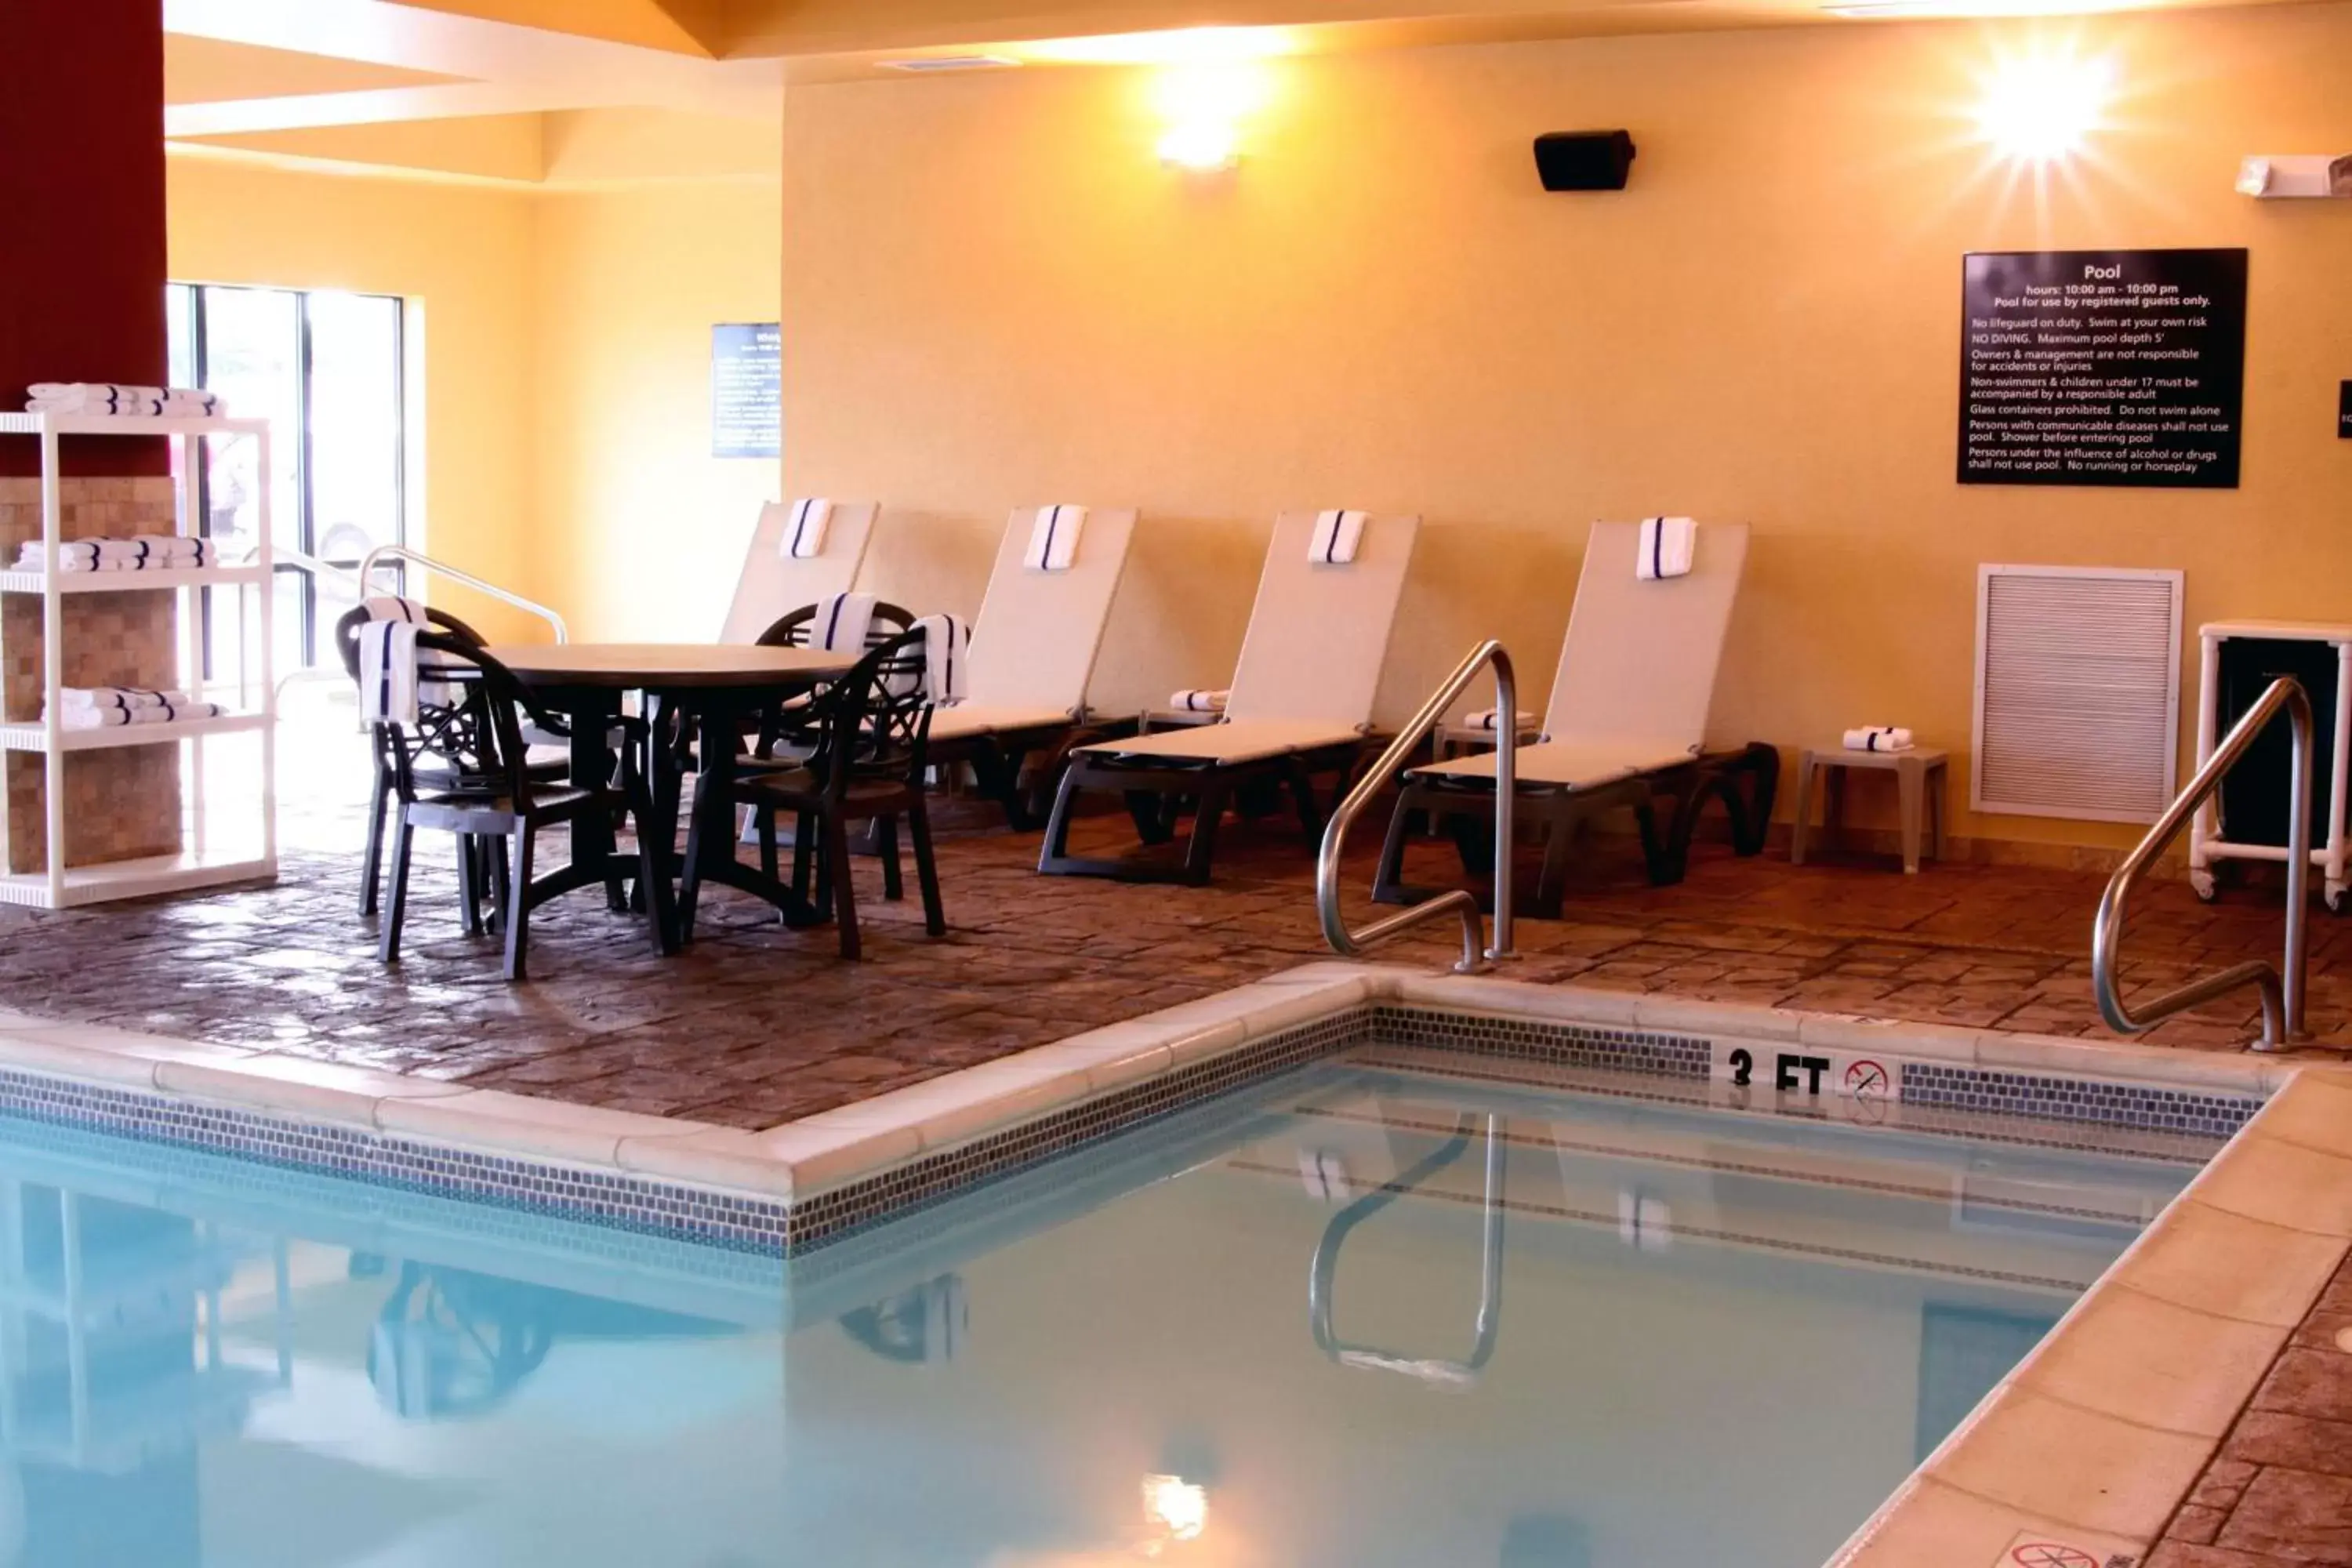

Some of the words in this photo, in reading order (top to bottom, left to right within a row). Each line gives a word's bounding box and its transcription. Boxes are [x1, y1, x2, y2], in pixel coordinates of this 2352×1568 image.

[2085, 264, 2121, 279] Pool
[2026, 285, 2061, 295] hours:
[2065, 285, 2095, 294] 10:00
[2127, 284, 2157, 293] 10:00
[2160, 285, 2179, 296] pm
[1994, 296, 2019, 307] Pool
[2022, 296, 2038, 307] for
[2064, 296, 2078, 309] by
[2082, 296, 2139, 308] registered
[2142, 296, 2180, 308] guests
[2183, 295, 2211, 307] only.
[1972, 319, 1987, 328] No
[1990, 318, 2038, 330] lifeguard
[2056, 318, 2083, 330] duty.
[2089, 318, 2118, 327] Swim
[2120, 318, 2131, 327] at
[2134, 318, 2158, 329] your
[2161, 318, 2185, 327] own
[2188, 317, 2207, 326] risk
[1972, 333, 1988, 343] NO
[1991, 333, 2031, 344] DIVING.
[2038, 334, 2090, 343] Maximum
[2093, 332, 2118, 345] pool
[2120, 332, 2152, 345] depth
[1972, 350, 2011, 359] Owners
[2013, 349, 2021, 359] &
[2024, 350, 2094, 361] management
[2117, 350, 2135, 359] not
[2138, 348, 2199, 360] responsible
[1972, 361, 1987, 370] for
[1989, 361, 2037, 371] accidents
[2053, 362, 2092, 373] injuries
[1971, 377, 2047, 387] Non-swimmers
[2049, 378, 2057, 387] &
[2060, 376, 2103, 387] children
[2106, 378, 2137, 387] under
[2142, 378, 2152, 387] 17
[2155, 378, 2182, 387] must
[2185, 377, 2199, 387] be
[1971, 389, 2038, 400] accompanied
[2041, 389, 2054, 400] by
[2066, 390, 2125, 400] responsible
[2129, 390, 2157, 399] adult
[1970, 405, 1995, 414] Glass
[1998, 405, 2053, 414] containers
[2119, 405, 2135, 415] Do
[2139, 406, 2157, 415] not
[2159, 405, 2187, 416] swim
[2190, 406, 2221, 416] alone
[1969, 420, 2008, 430] Persons
[2011, 420, 2034, 430] with
[2037, 420, 2113, 430] communicable
[2116, 421, 2158, 430] diseases
[2161, 422, 2187, 431] shall
[2189, 423, 2208, 431] not
[1969, 432, 1995, 443] pool.
[2001, 432, 2040, 441] Shower
[2042, 433, 2078, 442] before
[2081, 434, 2125, 445] entering
[2129, 434, 2154, 445] pool
[1969, 448, 2008, 457] Persons
[2010, 448, 2040, 457] under
[2044, 448, 2060, 457] the
[2064, 448, 2113, 459] influence
[2115, 449, 2127, 459] of
[2130, 449, 2169, 459] alcohol
[2187, 450, 2217, 463] drugs
[1969, 459, 1991, 468] shall
[1994, 459, 2012, 470] not
[2034, 460, 2061, 471] pool.
[2067, 460, 2083, 470] No
[2085, 462, 2129, 472] running
[2145, 462, 2198, 474] horseplay
[1729, 1048, 1752, 1085] 3
[1776, 1054, 1830, 1094] FT
